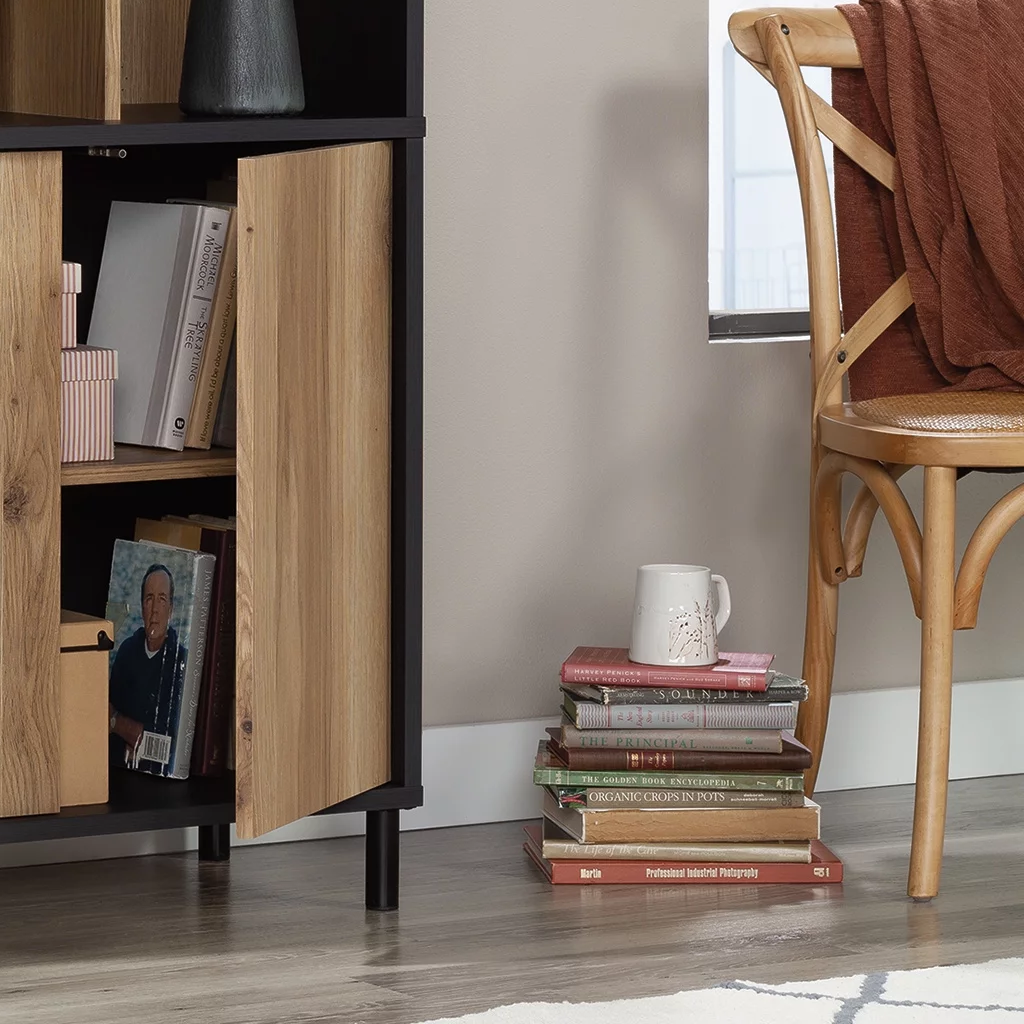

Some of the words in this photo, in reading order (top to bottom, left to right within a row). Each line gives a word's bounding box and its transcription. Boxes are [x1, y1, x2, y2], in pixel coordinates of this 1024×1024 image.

[196, 234, 215, 291] MOORCOCK
[207, 242, 223, 287] MICHAEL
[184, 322, 198, 349] TREE
[189, 322, 208, 382] SKRAYLING
[201, 420, 209, 436] love
[215, 344, 223, 367] about
[203, 569, 212, 602] JAMES
[195, 605, 208, 665] PATTERSON
[658, 689, 754, 699] SOUNDER
[579, 736, 608, 746] THE
[616, 738, 697, 749] PRINCIPAL
[603, 776, 637, 784] GOLDEN
[642, 777, 666, 785] BOOK
[670, 778, 736, 787] ENCYCLOPEDIA
[589, 791, 642, 802] ORGANIC
[643, 792, 680, 802] CROPS
[682, 792, 697, 802] IN
[697, 792, 725, 802] POTS
[564, 845, 580, 854] The
[583, 845, 602, 857] Life
[605, 845, 617, 857] of
[580, 868, 602, 879] Martin
[646, 868, 685, 879] Professional
[687, 868, 718, 879] Industrial
[719, 868, 759, 879] Photography
